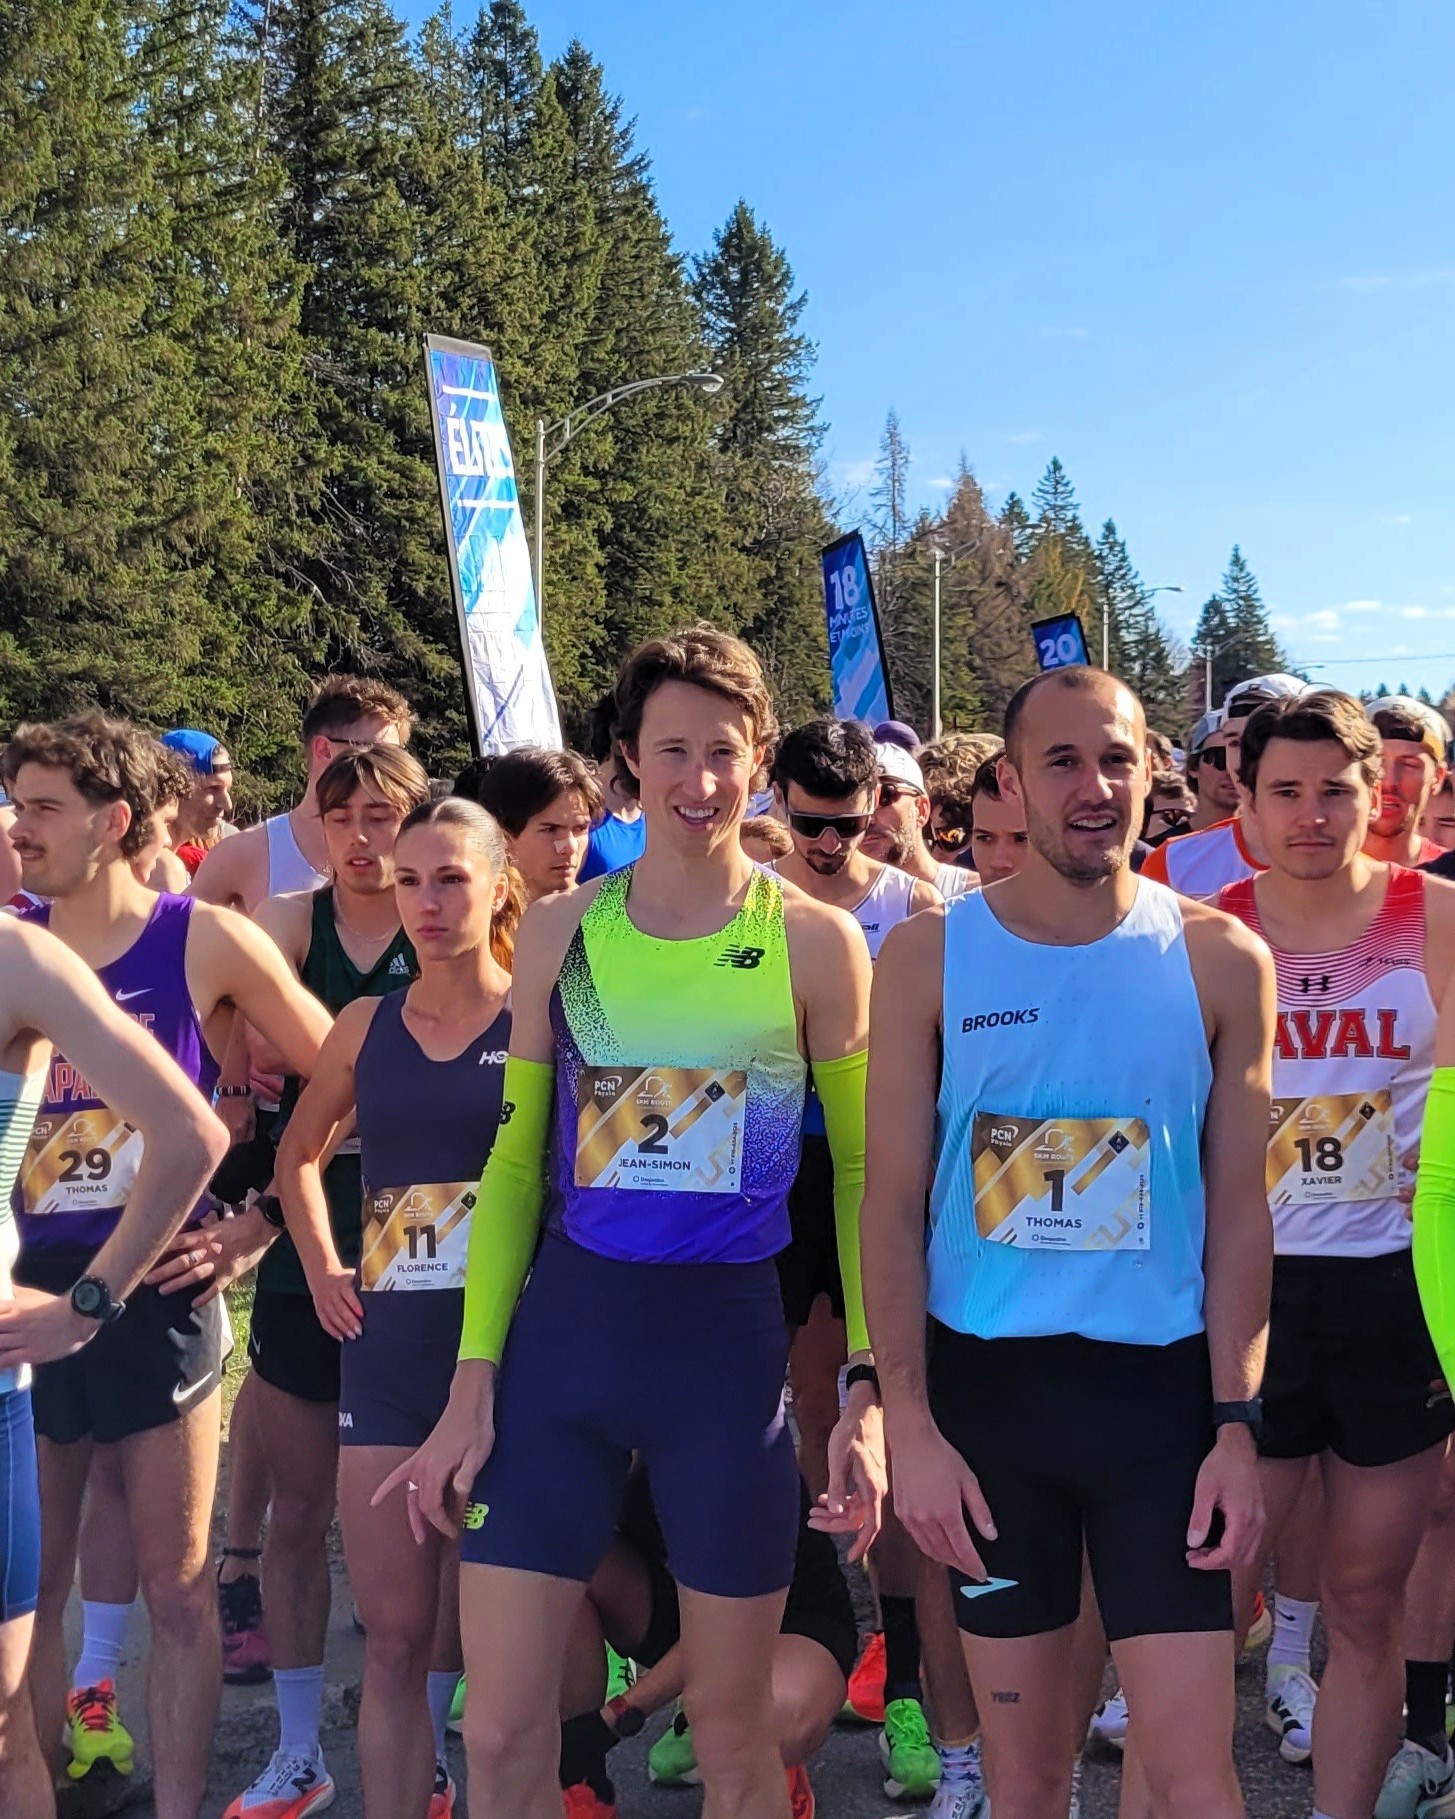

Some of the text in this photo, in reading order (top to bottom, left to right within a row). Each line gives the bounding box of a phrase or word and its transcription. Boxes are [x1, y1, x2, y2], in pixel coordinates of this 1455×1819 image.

[829, 565, 861, 610] 18
[1039, 633, 1077, 666] 20
[961, 1007, 1041, 1034] BROOKS
[594, 1080, 616, 1091] PCN
[637, 1113, 669, 1155] 2
[991, 1128, 1012, 1141] PCN
[618, 1158, 692, 1171] JEAN-SIMON
[1293, 1136, 1343, 1173] 18
[57, 1147, 112, 1183] 29
[65, 1184, 108, 1196] THOMAS
[1043, 1169, 1065, 1212] 1
[1300, 1175, 1343, 1186] XAVIER
[374, 1199, 389, 1209] PCN
[1025, 1216, 1083, 1229] THOMAS
[402, 1222, 437, 1260] 11
[396, 1262, 449, 1273] FLORENCE
